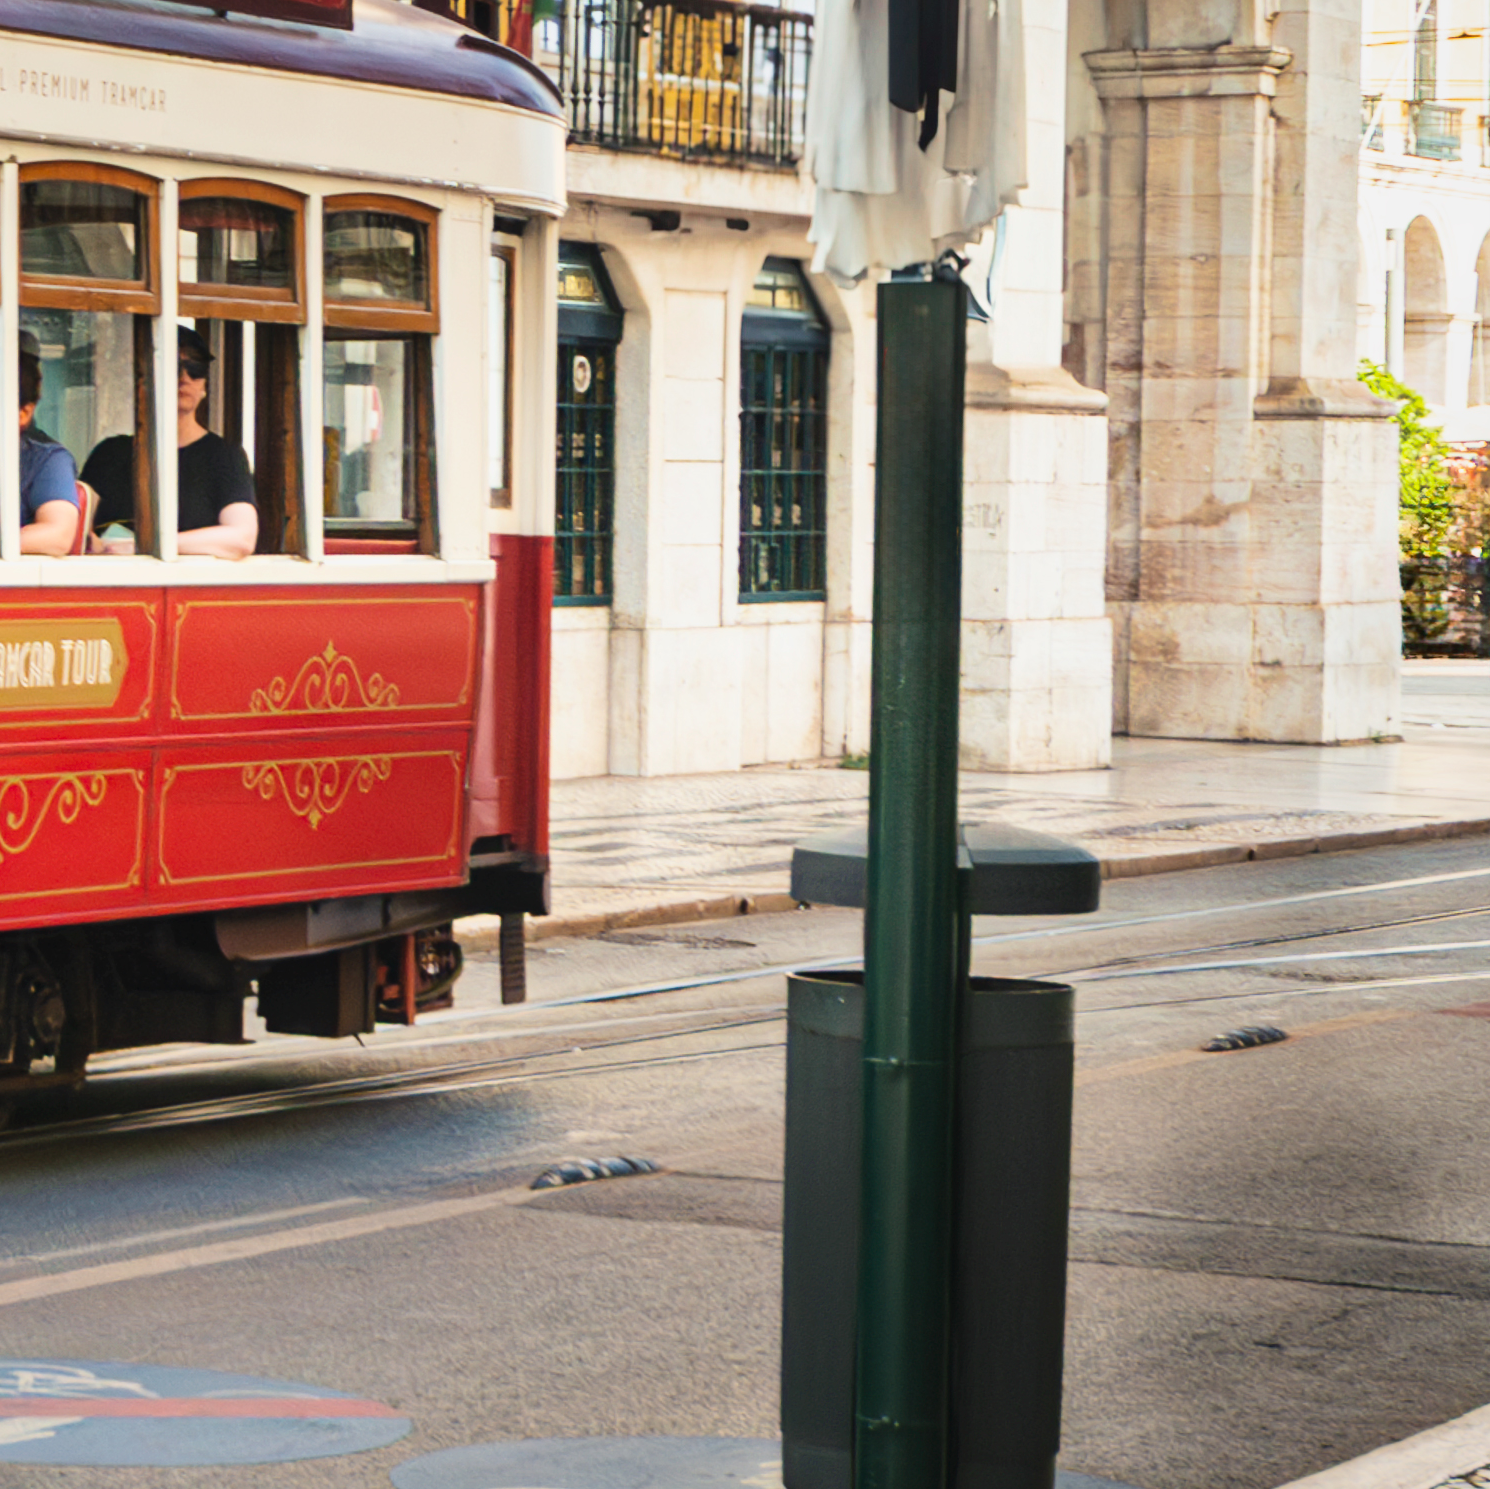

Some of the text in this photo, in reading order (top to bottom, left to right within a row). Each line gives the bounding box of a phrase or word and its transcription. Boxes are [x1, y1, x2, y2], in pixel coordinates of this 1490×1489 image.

[19, 69, 90, 102] PREMIUM
[101, 80, 167, 112] TRAMCAR
[60, 638, 114, 686] TOUR
